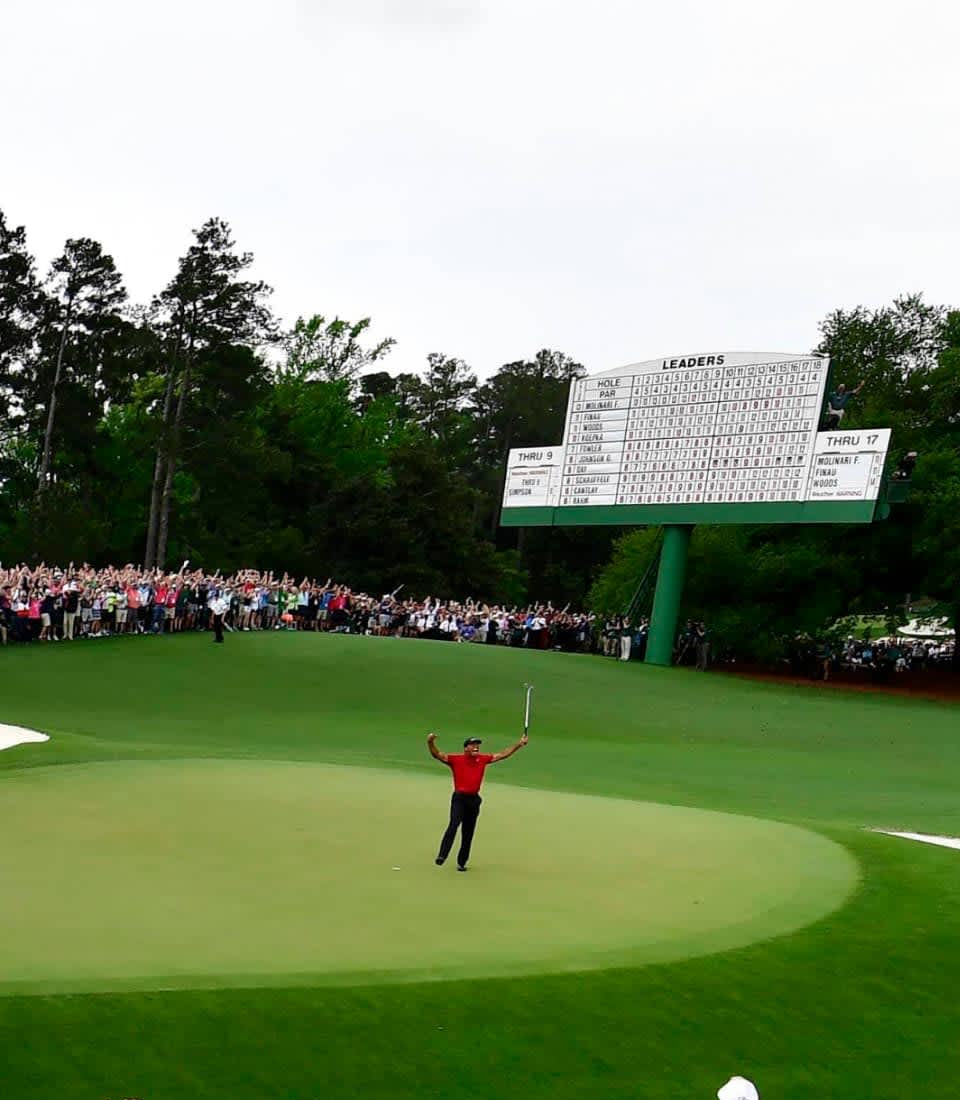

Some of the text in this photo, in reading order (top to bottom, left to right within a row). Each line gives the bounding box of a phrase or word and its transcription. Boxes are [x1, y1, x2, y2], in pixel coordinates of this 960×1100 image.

[662, 355, 724, 370] LEADERS
[637, 377, 641, 385] 1
[646, 375, 651, 384] 2
[655, 375, 660, 383] 3
[674, 373, 680, 381] 5
[685, 372, 690, 380] 6
[695, 371, 700, 379] 7
[714, 370, 720, 378] 9
[726, 369, 734, 377] 10
[737, 368, 744, 376] 11
[747, 367, 755, 375] 12
[758, 366, 766, 374] 13
[768, 365, 776, 373] 14
[802, 362, 810, 370] 17
[813, 361, 821, 369] 18
[597, 378, 621, 388] HOLE
[600, 389, 616, 398] PAR
[826, 434, 879, 447] THRU 17
[518, 451, 553, 461] THRU 9
[817, 456, 852, 465] MOLINARI
[816, 468, 837, 476] FINAU
[813, 479, 838, 488] WOODS
